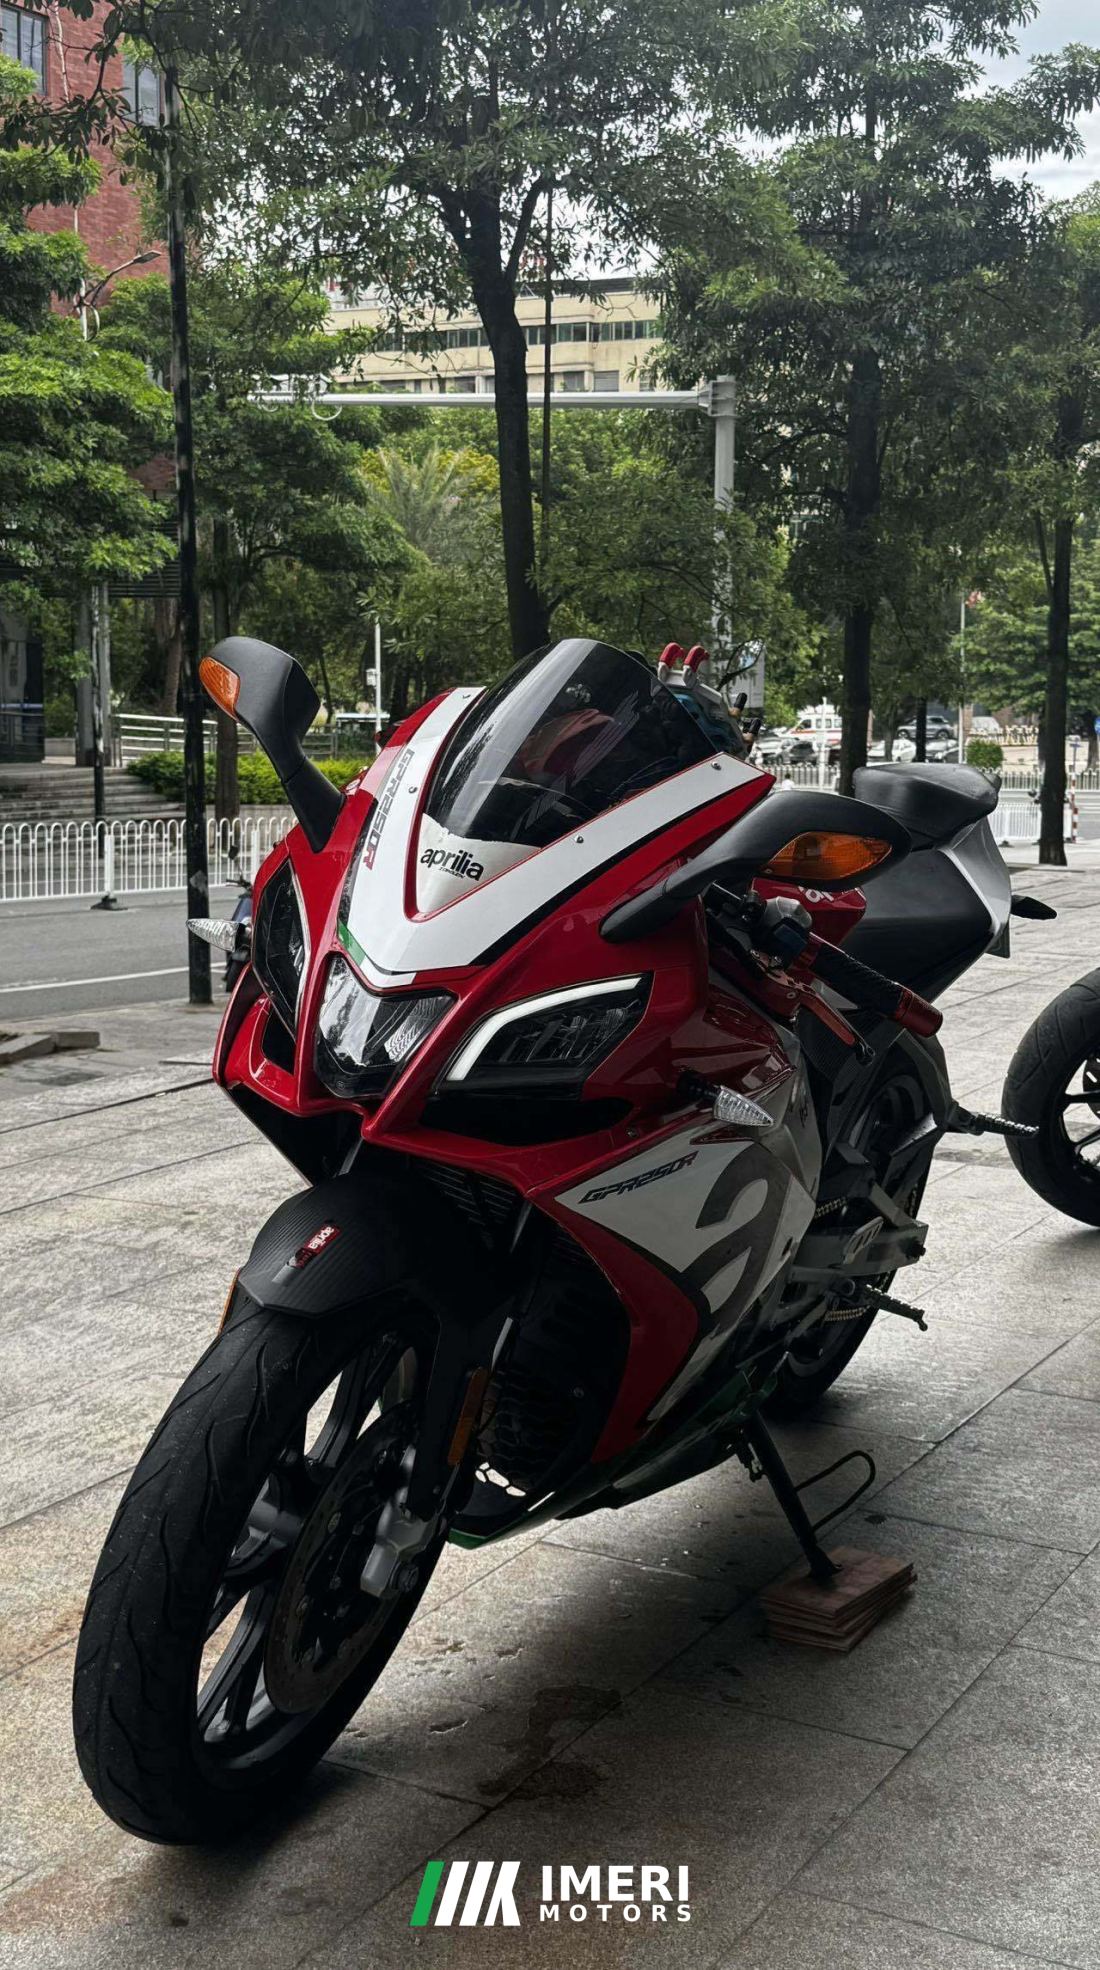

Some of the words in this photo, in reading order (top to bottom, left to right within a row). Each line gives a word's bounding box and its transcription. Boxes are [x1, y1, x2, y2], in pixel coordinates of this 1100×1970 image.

[363, 748, 415, 870] GPR250R
[420, 847, 485, 881] aprilia
[578, 1150, 699, 1204] GPR250R
